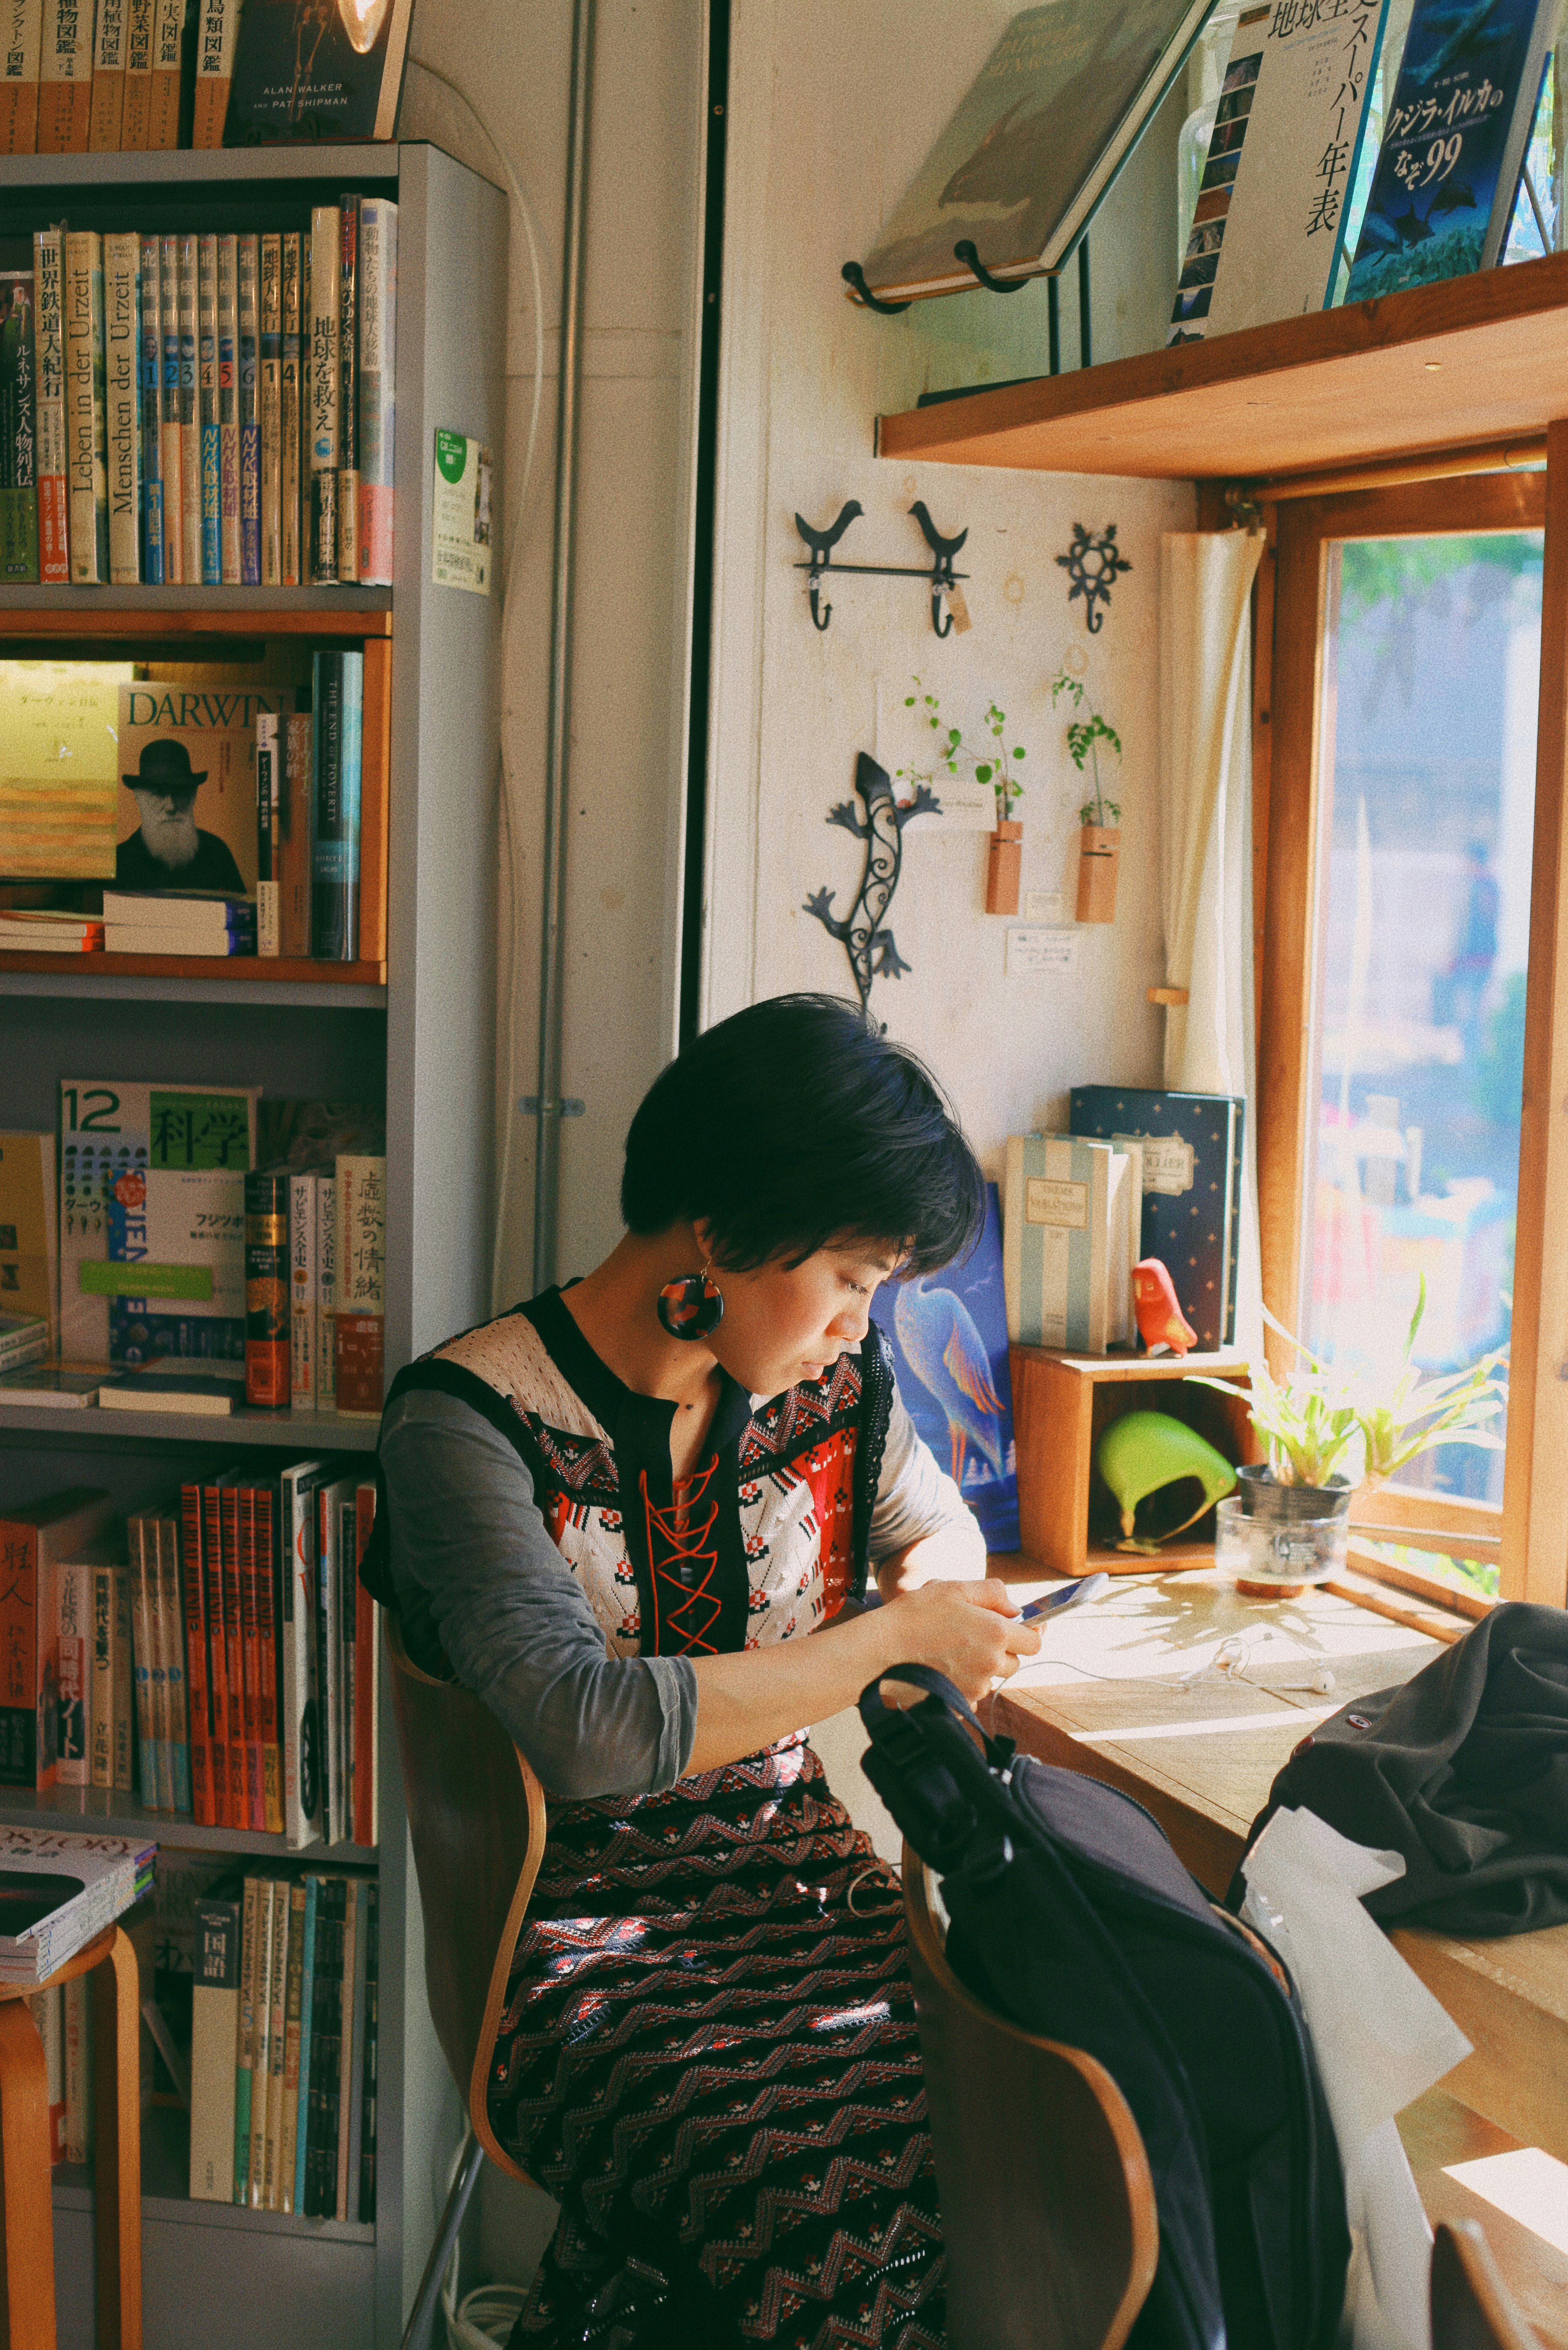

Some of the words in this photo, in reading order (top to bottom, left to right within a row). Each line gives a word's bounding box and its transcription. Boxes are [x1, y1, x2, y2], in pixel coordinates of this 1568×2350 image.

[263, 86, 293, 96] ALAN
[297, 84, 343, 94] WALKER
[297, 97, 348, 107] SHIPMAN
[68, 268, 90, 341] Urzeit
[110, 271, 130, 341] Urzeit
[40, 248, 63, 398] 世界鉄道大紀行
[69, 350, 90, 386] der
[111, 354, 131, 390] der
[145, 365, 154, 385] 1
[165, 365, 177, 384] 2
[182, 364, 193, 384] 3
[220, 365, 231, 383] 5
[242, 365, 254, 385] 6
[265, 363, 274, 383] 1
[283, 364, 296, 383] 4
[312, 315, 336, 431] 地球を救え
[15, 344, 34, 486] ルネサンス人物列伝
[71, 393, 92, 416] in
[72, 420, 94, 494] Leben
[112, 400, 132, 515] Menschen
[329, 680, 338, 706] THE
[328, 714, 337, 741] END
[328, 764, 336, 823] POVERTY
[64, 1088, 121, 1131] 12
[152, 1109, 249, 1165] 科学
[295, 1186, 307, 1268] サピエンス全史
[321, 1187, 335, 1269] サピエンス全史
[354, 1171, 384, 1301] 虚数の情緒
